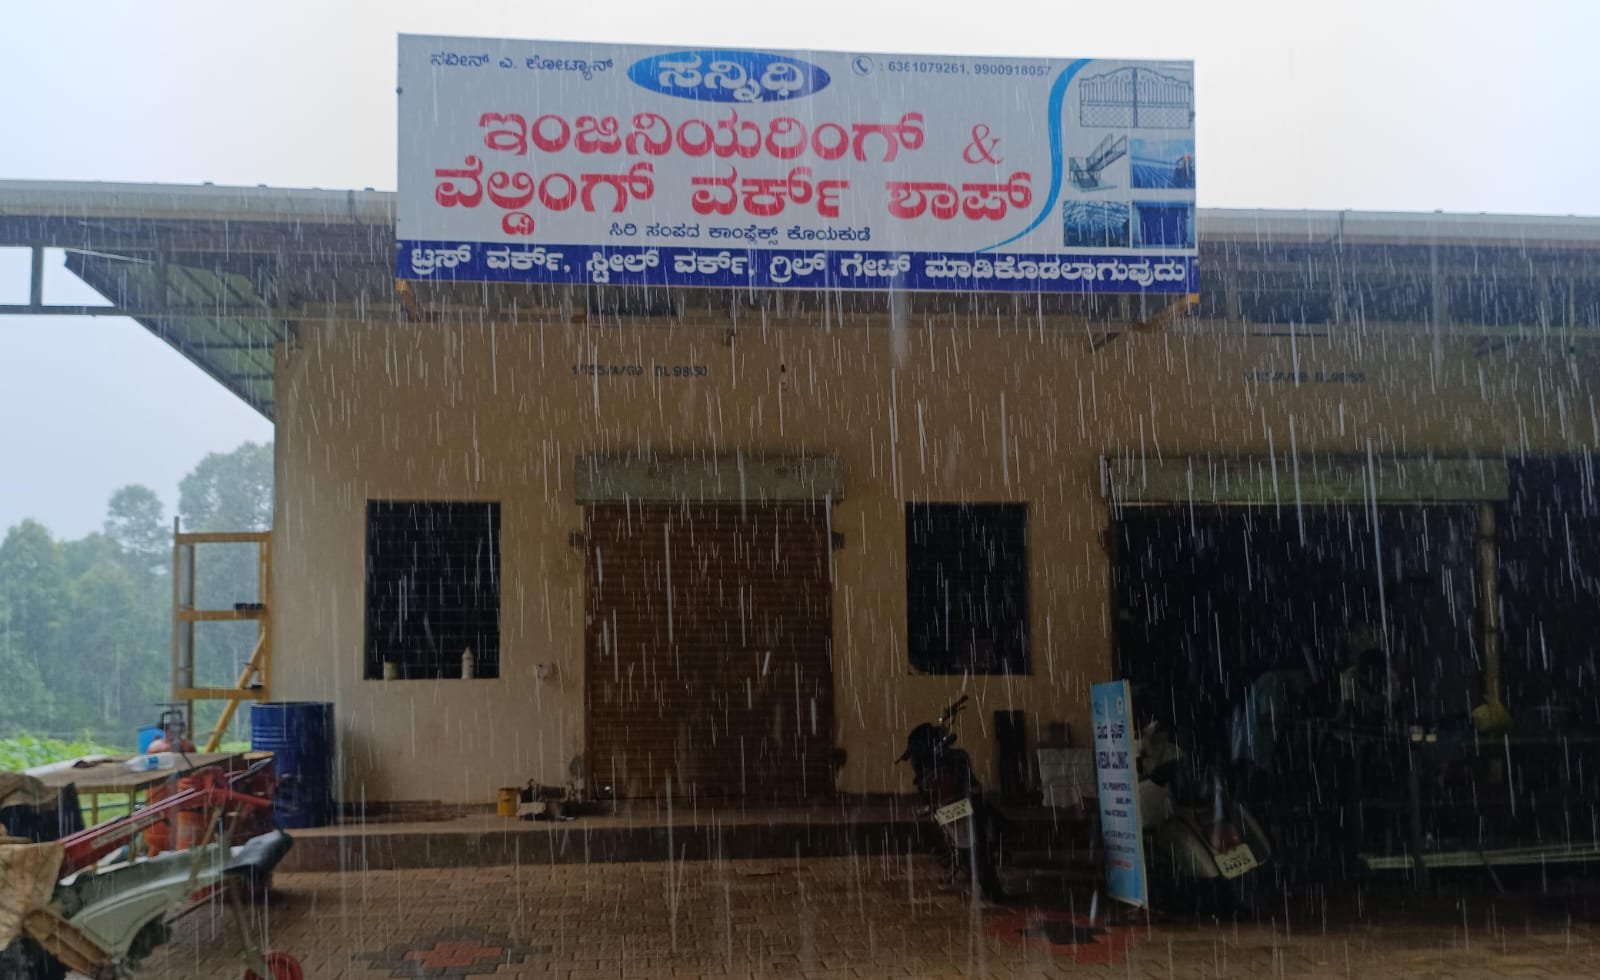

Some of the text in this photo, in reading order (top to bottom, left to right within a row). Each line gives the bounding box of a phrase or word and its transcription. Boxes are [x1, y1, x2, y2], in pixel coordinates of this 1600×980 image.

[657, 53, 805, 102] ಸನ್ನಿಧಿ
[974, 63, 1052, 76] 9900918057
[479, 107, 1004, 166] ಇಂಜಿನಿಯರಿಂಗ್ &
[435, 155, 1032, 235] ವೆಲ್ಡಿಂಗ್ ವರ್ಕ್ ಶಾಪ್
[609, 222, 637, 237] ಸಿರಿ
[646, 222, 700, 237] ಸಂಪದ
[411, 244, 471, 275] ಟ್ರಸ್
[586, 250, 660, 283] ಸ್ಟೀಲ್
[769, 252, 827, 284] ಗ್ರಿಲ್
[841, 253, 911, 279] ಗೇಟ್
